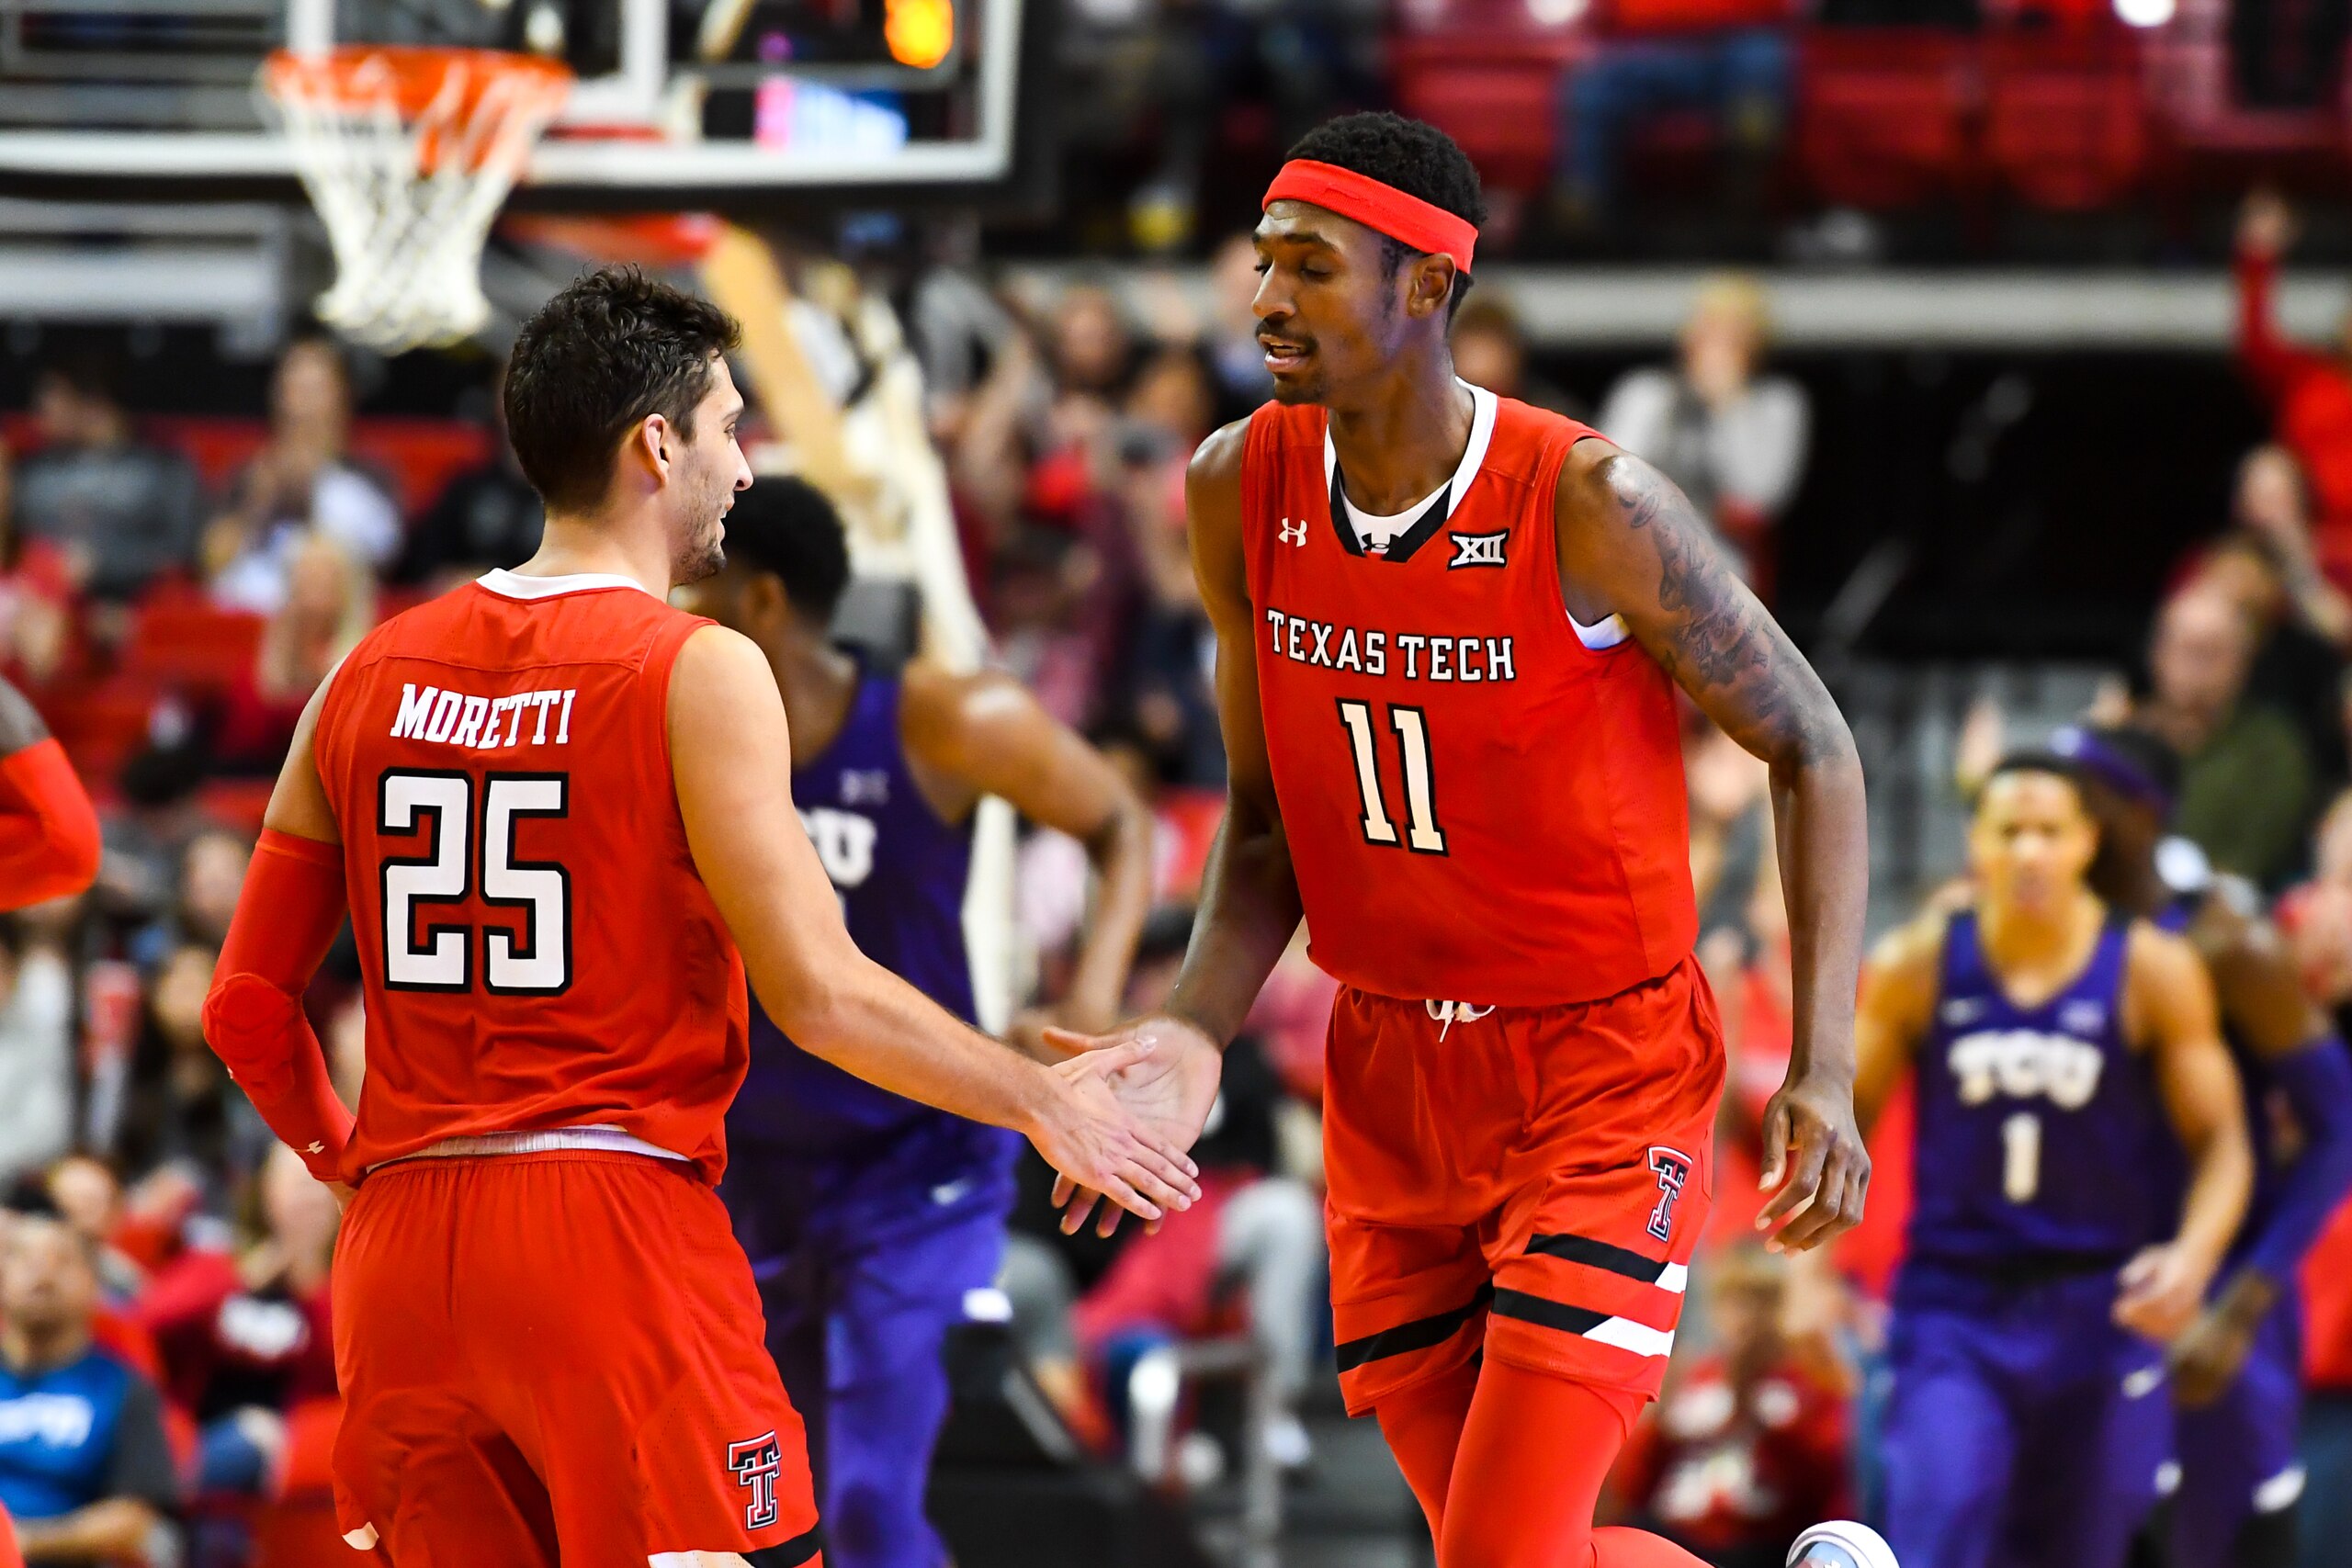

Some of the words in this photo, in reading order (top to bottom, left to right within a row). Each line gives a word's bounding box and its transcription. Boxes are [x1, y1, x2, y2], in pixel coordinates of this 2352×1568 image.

[1448, 530, 1509, 570] XII
[1267, 608, 1385, 676] TEXAS
[1397, 635, 1516, 682] TECH
[390, 682, 577, 750] MORETTI
[1337, 698, 1448, 855] 11
[379, 768, 572, 995] 25
[1948, 1028, 2104, 1111] TCU
[2001, 1112, 2041, 1203] 1
